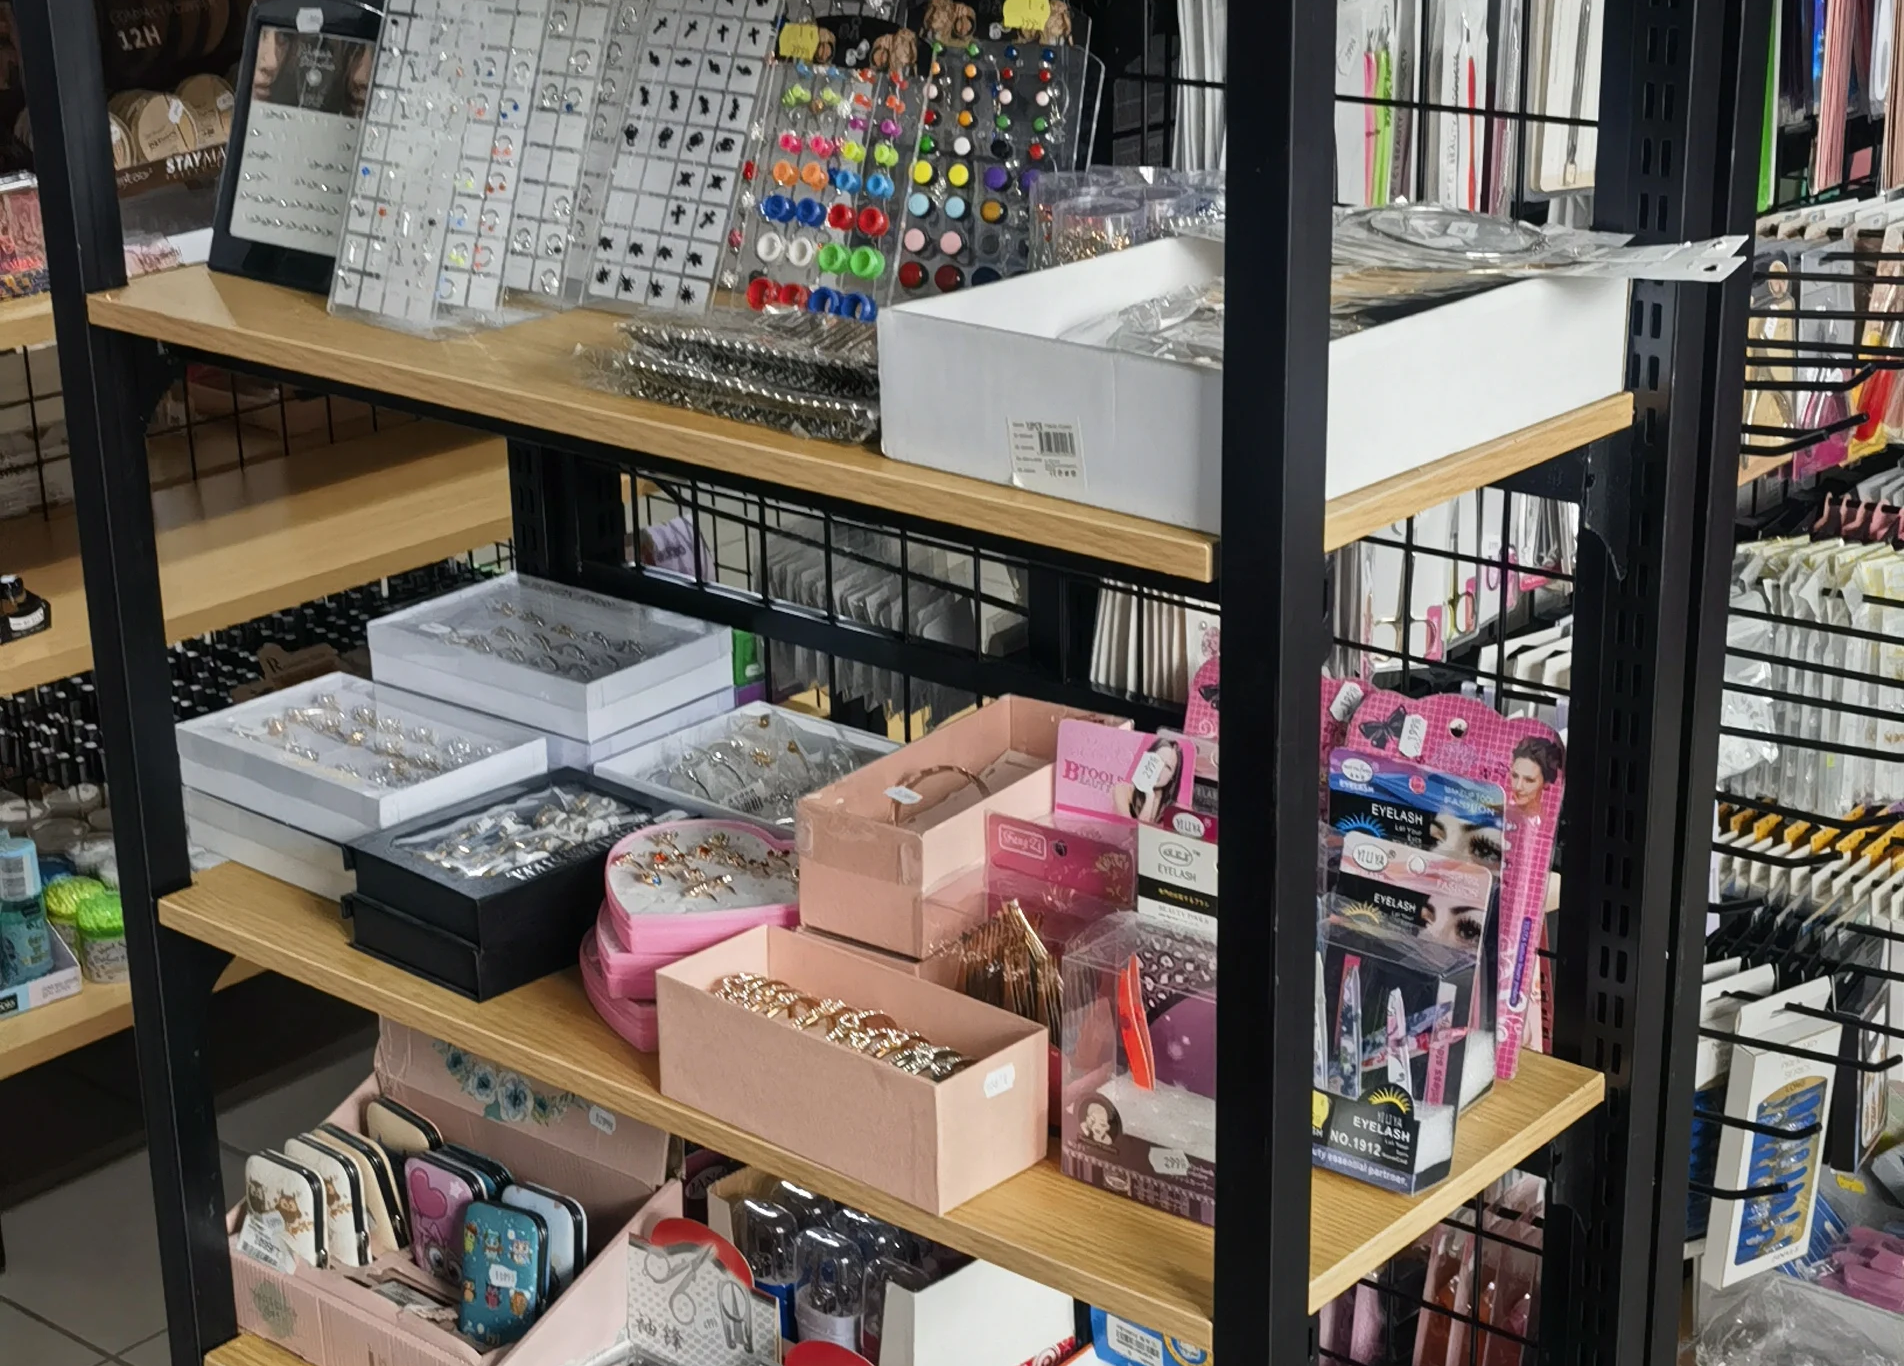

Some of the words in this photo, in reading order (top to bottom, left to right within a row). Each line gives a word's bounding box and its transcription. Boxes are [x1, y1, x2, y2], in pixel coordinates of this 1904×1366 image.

[117, 23, 162, 51] 12H
[1371, 802, 1424, 826] EYELASH
[1157, 863, 1197, 883] EYELASH
[1373, 892, 1417, 913] EYELASH
[1352, 1115, 1411, 1143] EYELASH
[1329, 1129, 1382, 1157] NO.1912
